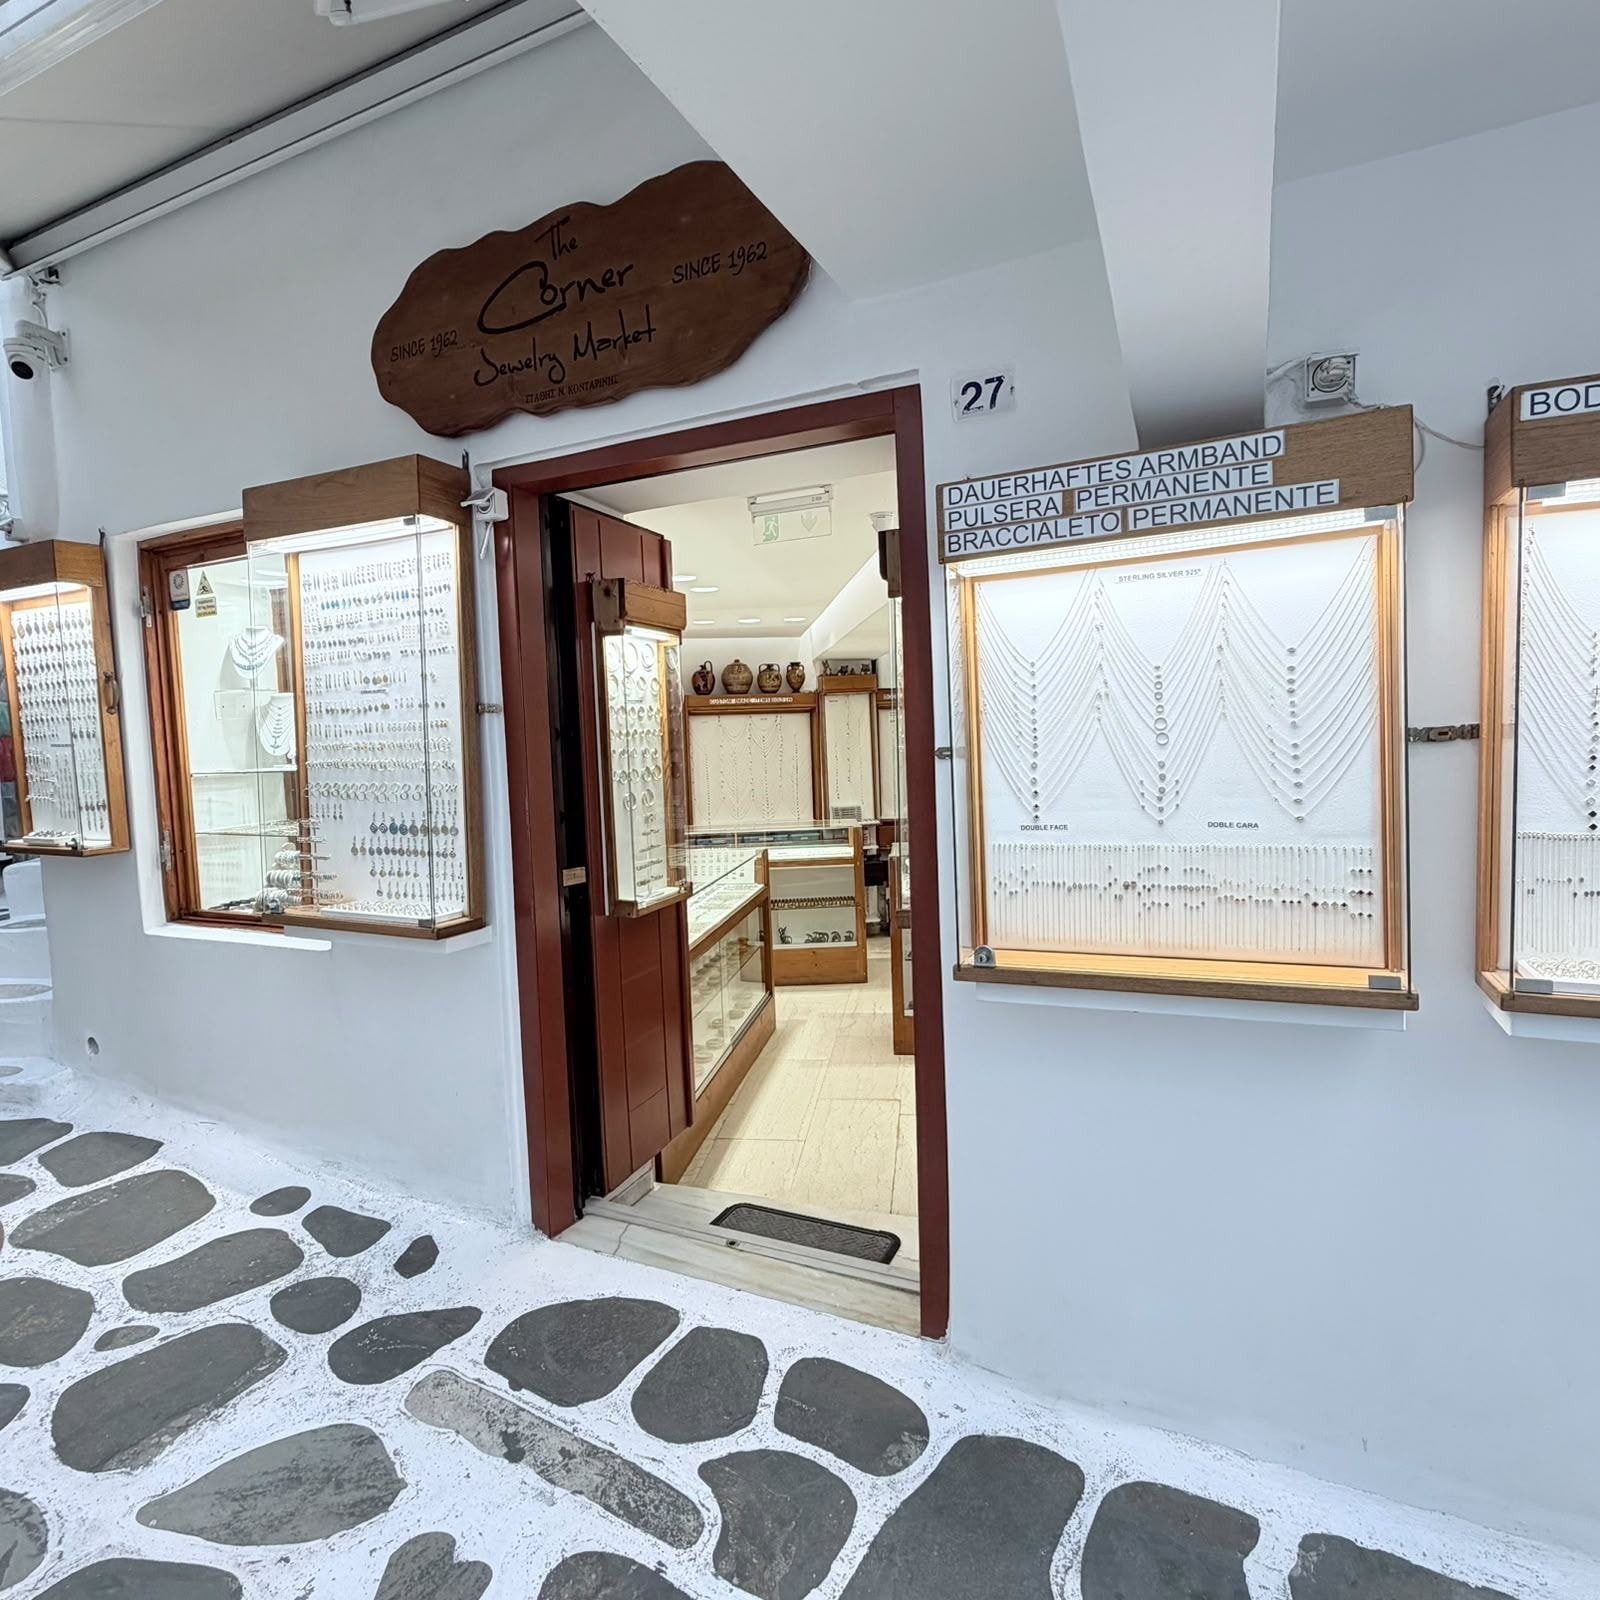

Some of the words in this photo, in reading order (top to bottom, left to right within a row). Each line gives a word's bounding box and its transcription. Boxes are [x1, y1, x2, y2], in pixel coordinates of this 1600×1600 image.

[534, 216, 579, 261] The
[672, 252, 721, 284] SINCE
[727, 241, 768, 276] 1962
[476, 260, 635, 335] Corner
[390, 337, 425, 362] SINCE
[430, 329, 458, 358] 1962
[473, 338, 564, 385] Jewelry
[573, 304, 657, 360] Market
[961, 374, 1005, 415] 27
[947, 459, 1132, 506] DAUERHAFTES
[1138, 434, 1282, 477] ARMBAND
[947, 511, 1120, 553] BRACCIALETO
[1132, 482, 1336, 529] PERMANENTE
[948, 496, 1060, 530] PULSERA
[1077, 462, 1270, 510] PERMANENTE
[1118, 573, 1155, 583] STERLING
[1156, 570, 1184, 579] SILVER
[1049, 823, 1069, 831] FACE
[1207, 821, 1234, 829] DOBLE
